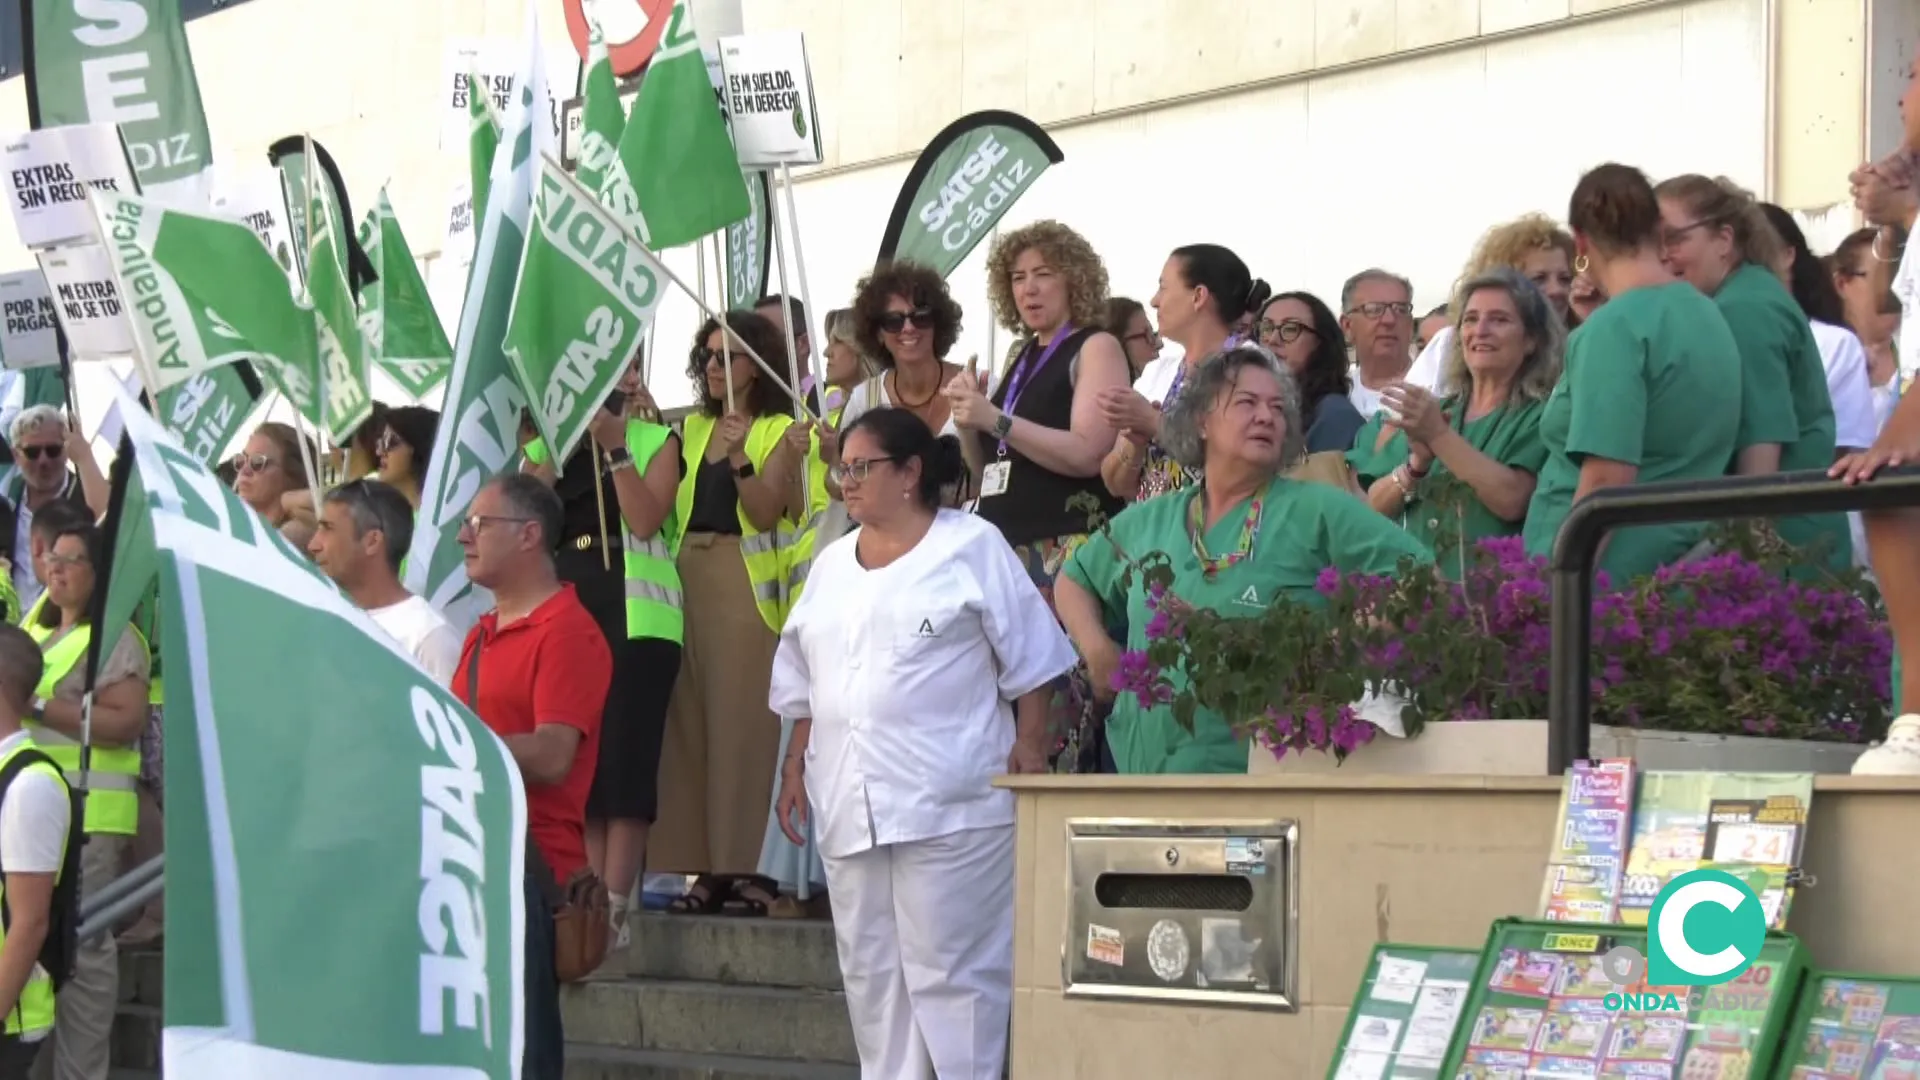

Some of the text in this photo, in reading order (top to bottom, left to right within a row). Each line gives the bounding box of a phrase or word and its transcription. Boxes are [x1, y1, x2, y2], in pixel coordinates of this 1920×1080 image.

[730, 74, 741, 93] ES
[733, 95, 743, 114] ES
[744, 94, 755, 113] MI
[755, 91, 801, 113] DERECHO
[12, 163, 74, 189] EXTRAS
[920, 134, 1008, 234] SATSE
[18, 187, 47, 209] SIN
[942, 157, 1033, 252] Cádiz
[57, 278, 116, 300] MI EXTRA
[106, 200, 189, 370] Andalucía
[4, 298, 35, 317] POR
[64, 302, 83, 320] NO
[83, 301, 100, 318] SE
